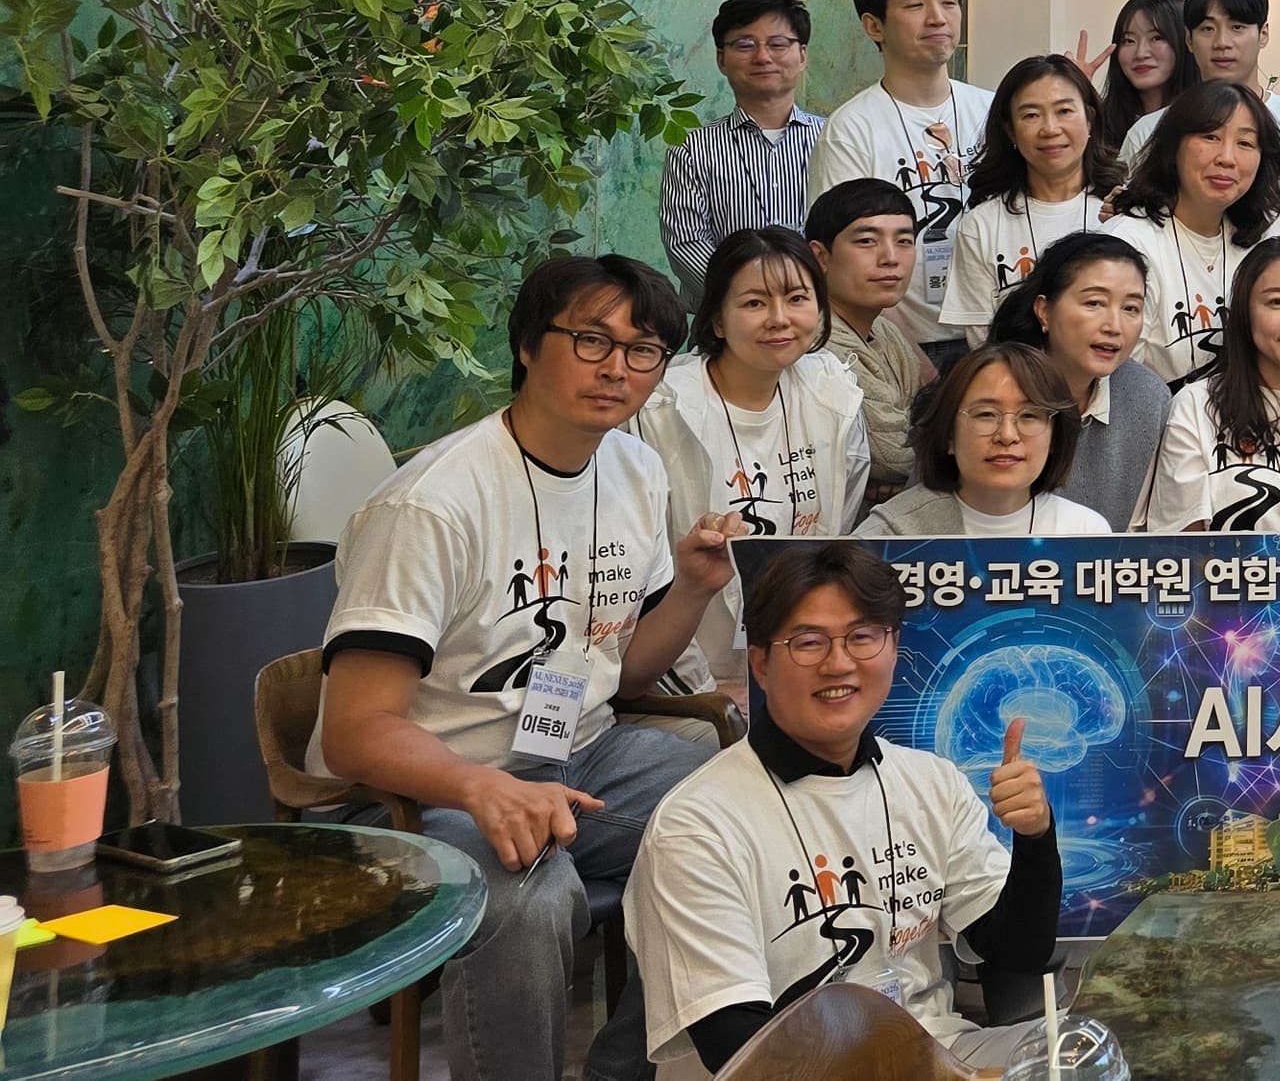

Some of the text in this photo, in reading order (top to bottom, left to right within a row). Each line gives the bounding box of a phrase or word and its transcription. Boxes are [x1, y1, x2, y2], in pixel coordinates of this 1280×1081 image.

[783, 466, 817, 485] mak
[788, 488, 817, 504] the
[588, 540, 626, 560] Let's
[588, 564, 632, 584] make
[1076, 557, 1193, 604] 대학원
[588, 590, 619, 608] the
[871, 840, 917, 865] Let's
[878, 865, 928, 891] make
[883, 887, 945, 915] the roa
